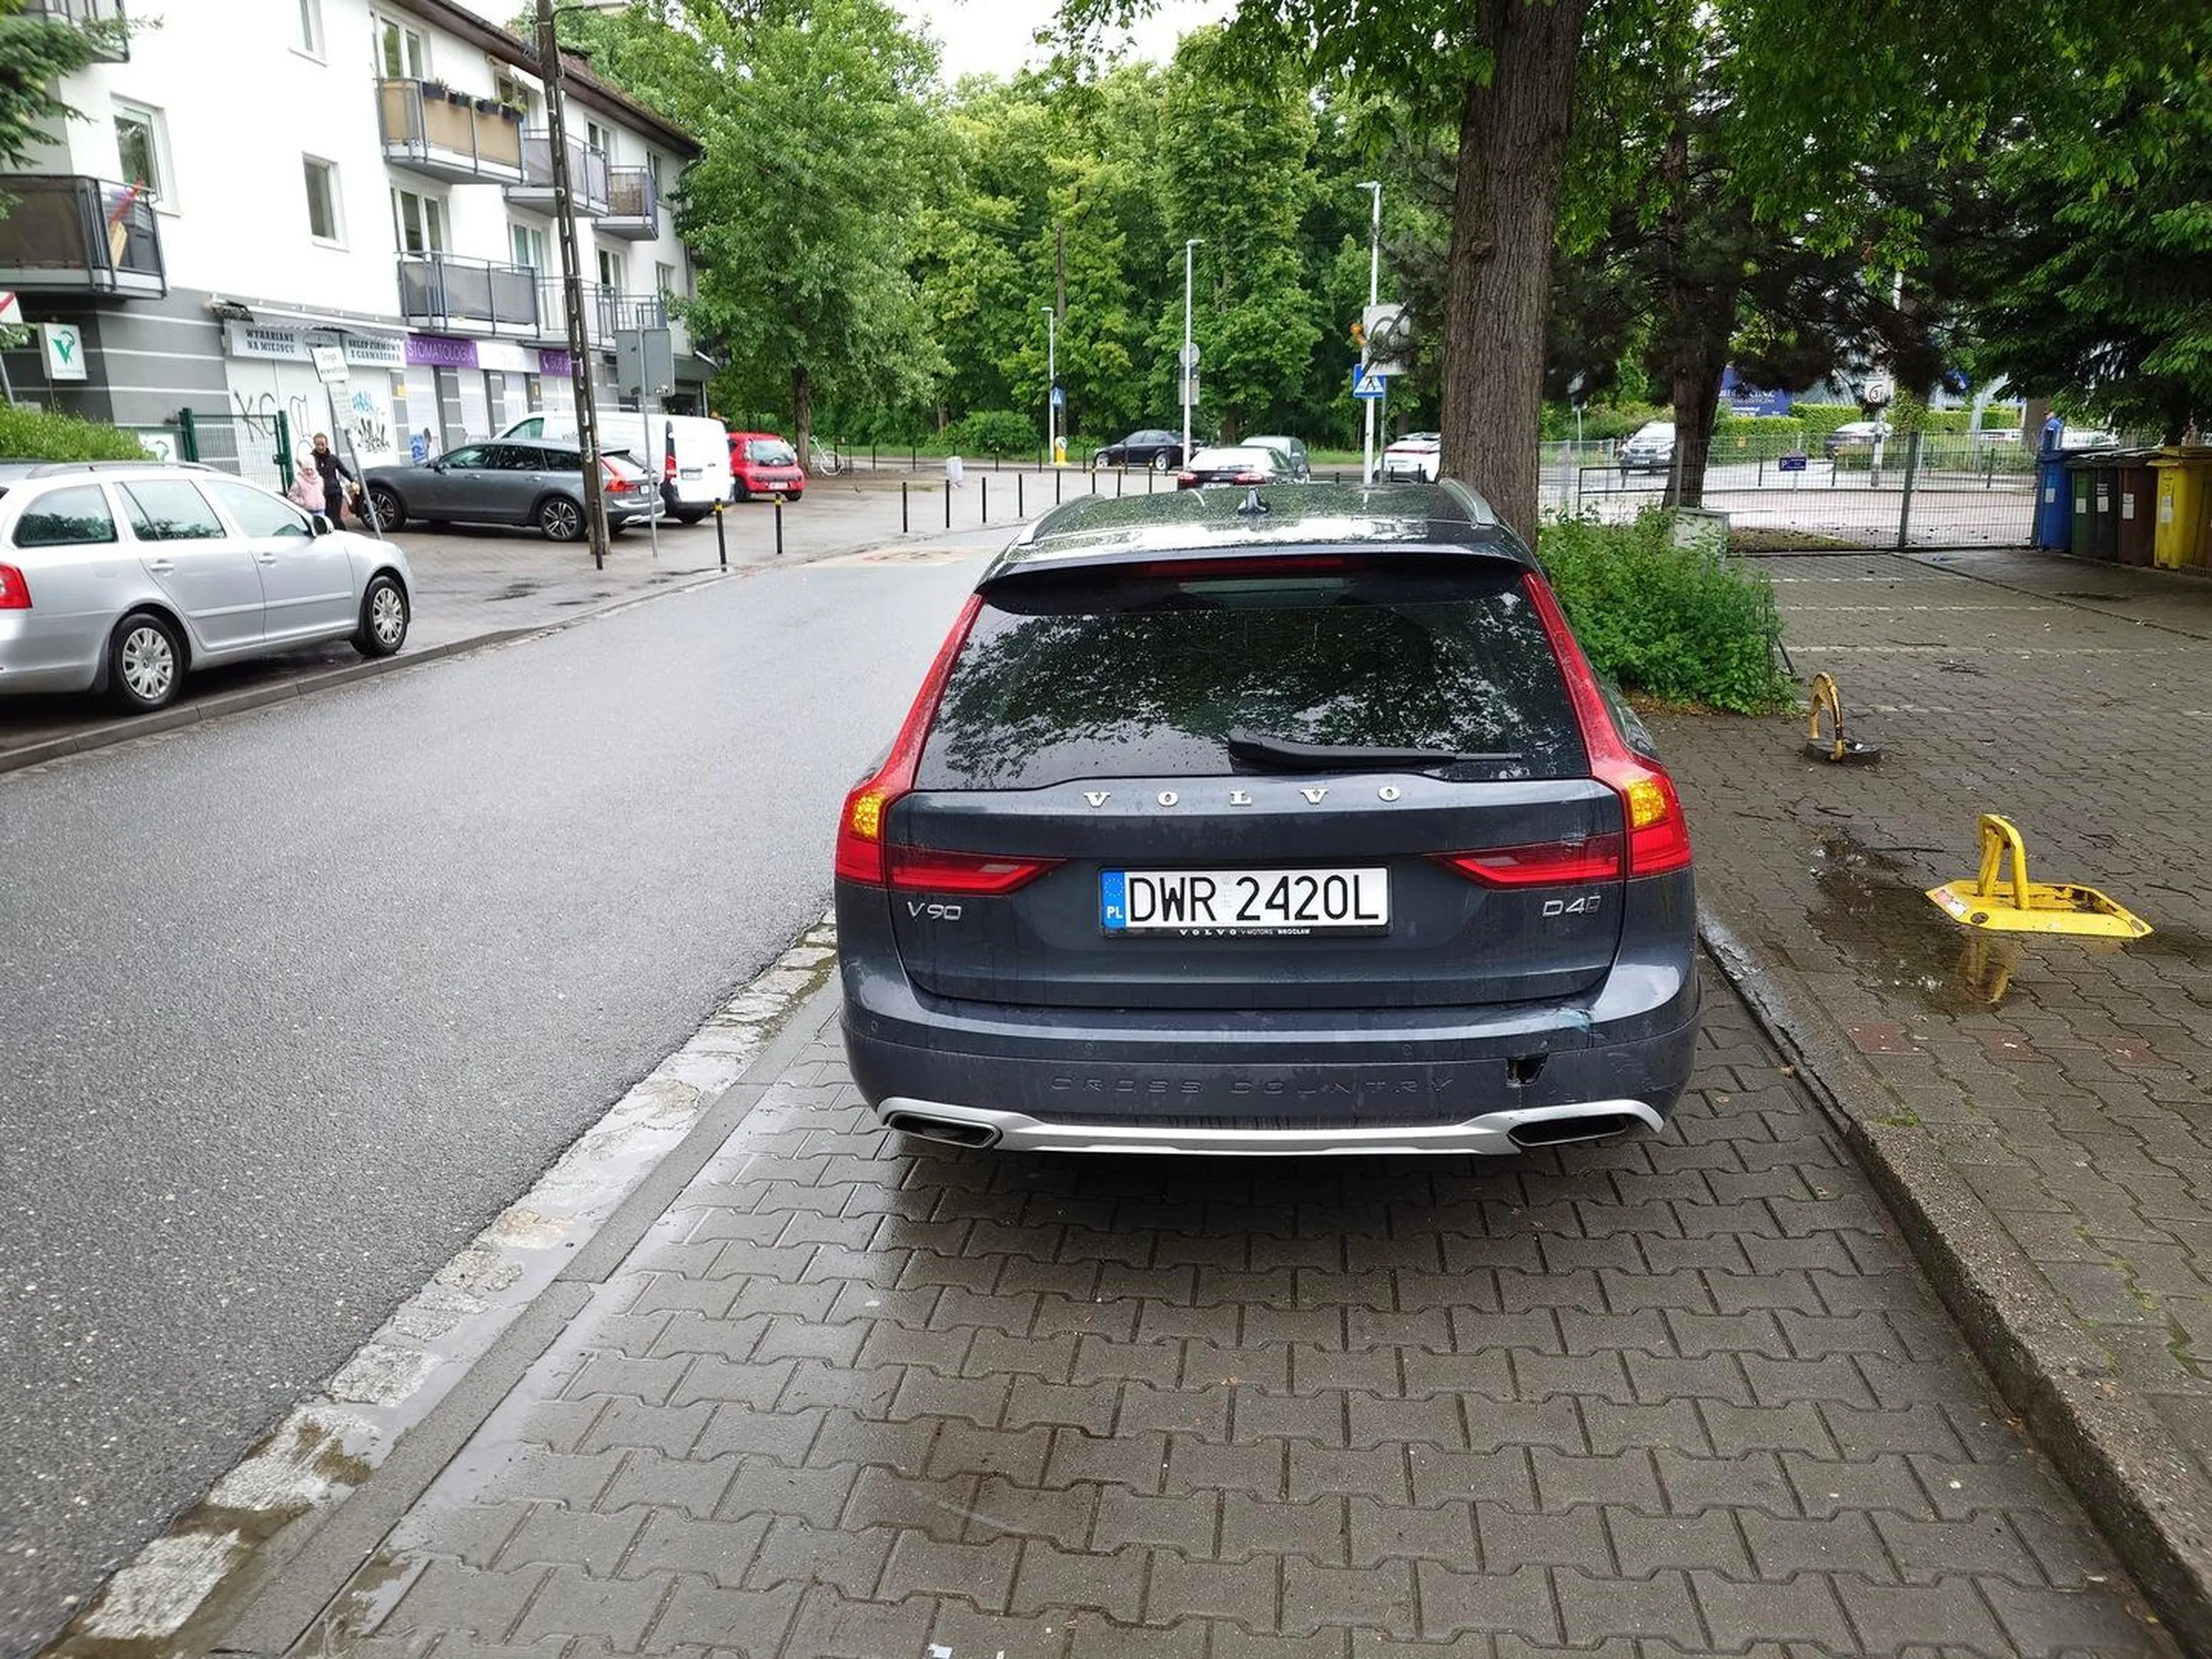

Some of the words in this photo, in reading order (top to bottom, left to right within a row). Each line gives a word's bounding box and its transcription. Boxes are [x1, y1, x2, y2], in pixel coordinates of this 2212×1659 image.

[1083, 786, 1402, 807] VOLVO
[1107, 907, 1123, 919] PL
[1129, 876, 1217, 923] DWR
[1236, 875, 1379, 922] 2420L
[907, 901, 962, 920] V90
[1050, 1077, 1204, 1094] CROSS
